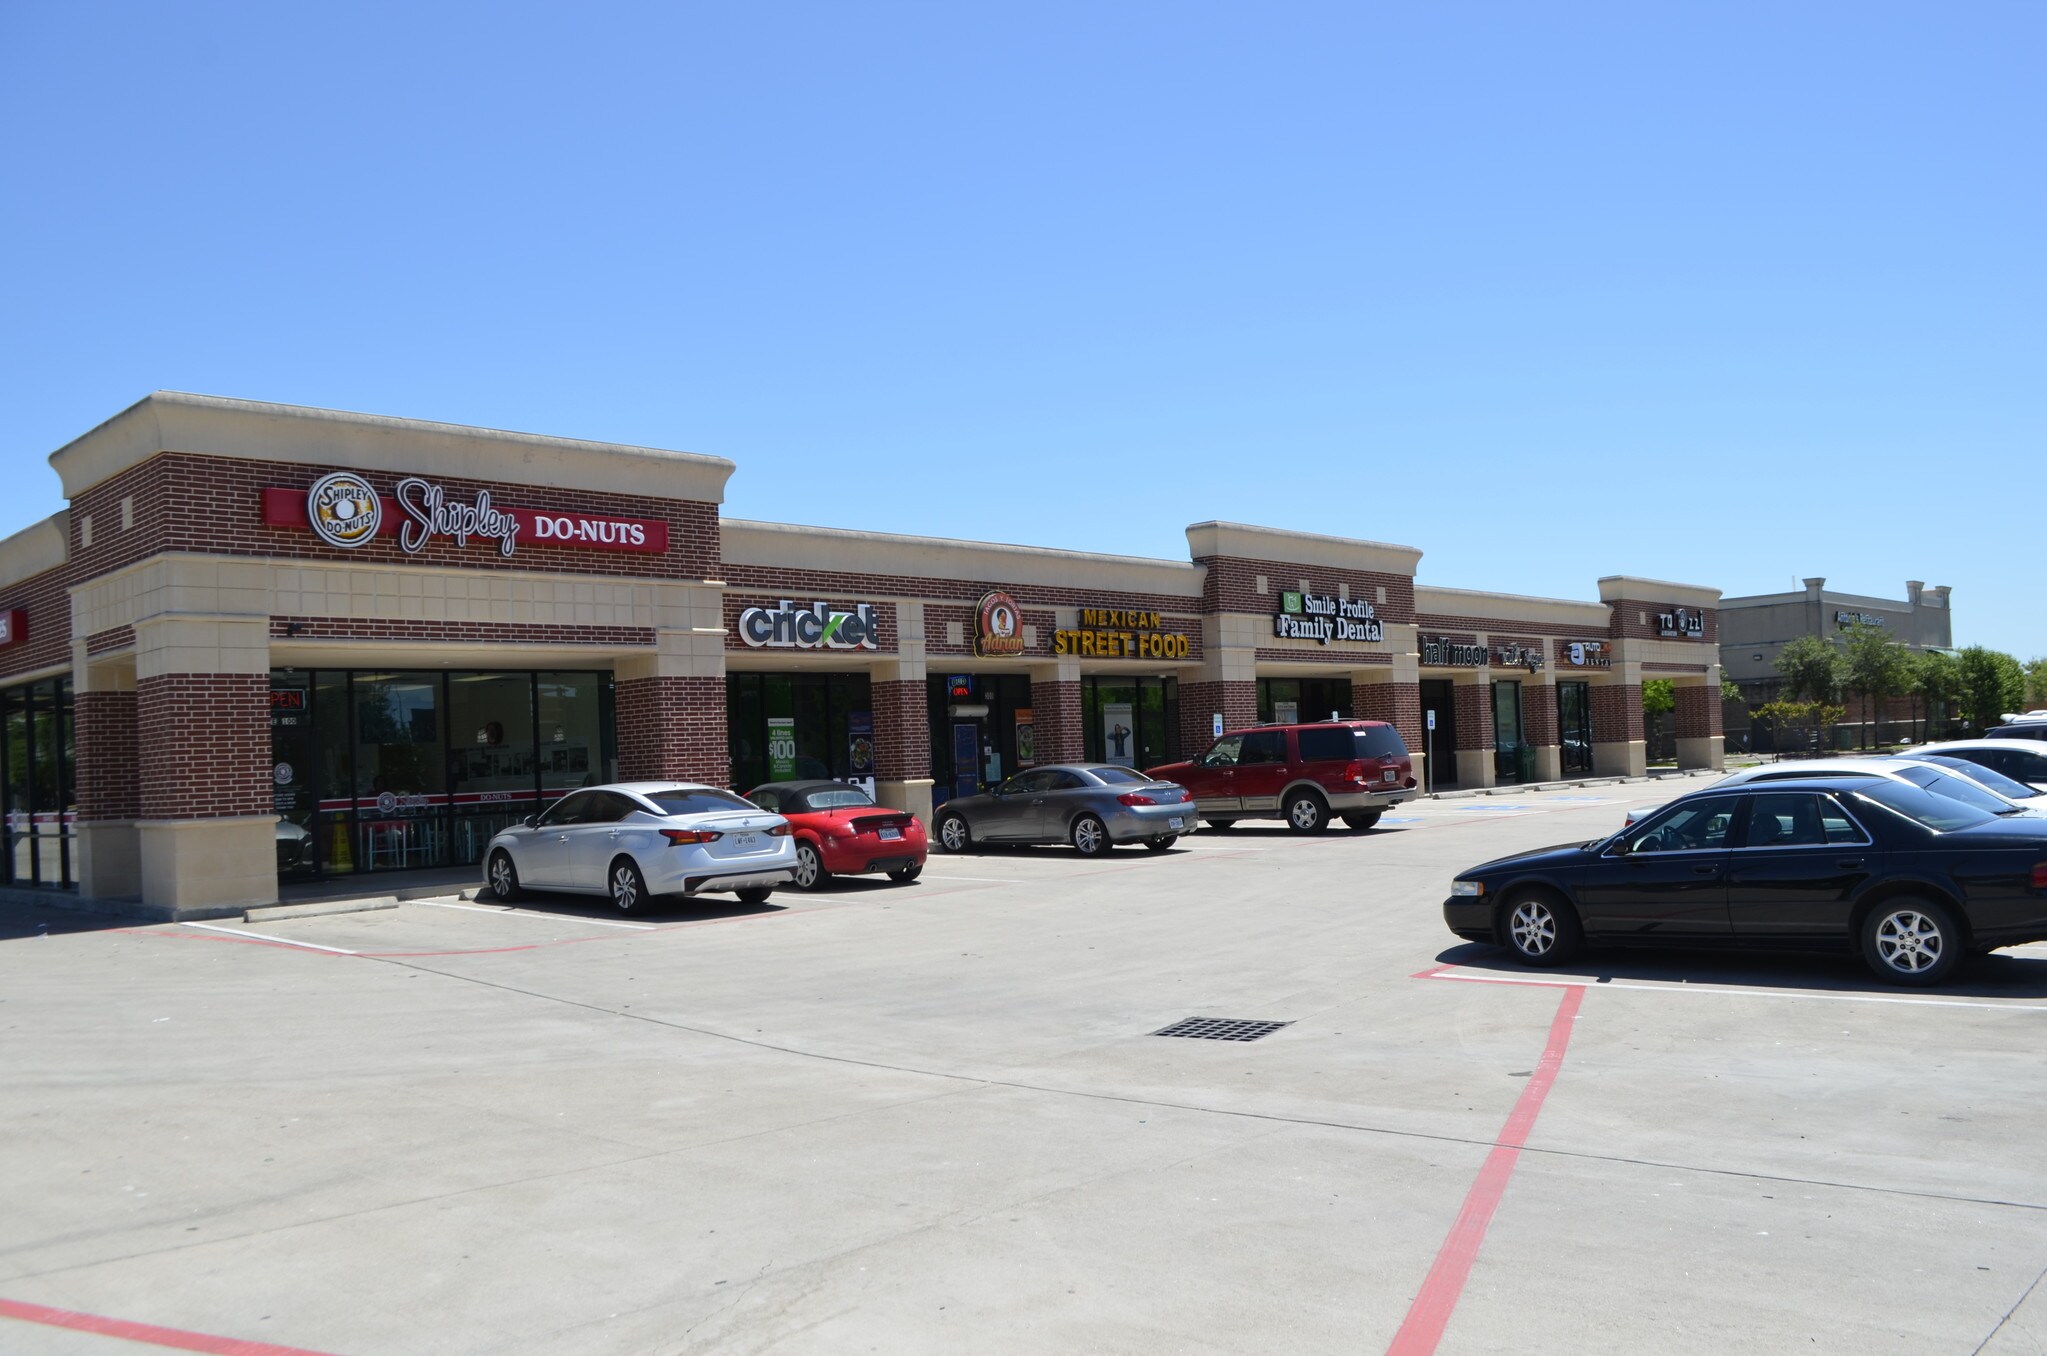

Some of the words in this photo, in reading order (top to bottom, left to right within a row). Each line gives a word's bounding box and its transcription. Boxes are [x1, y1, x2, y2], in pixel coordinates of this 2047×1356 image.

[319, 486, 369, 506] SHIPLEY
[396, 477, 520, 557] Shipley
[535, 516, 645, 545] DO-NUTS
[1305, 594, 1337, 615] Smile
[1339, 598, 1375, 620] Profile
[739, 600, 879, 649] cricket
[1083, 608, 1161, 629] MEXICAN
[1279, 613, 1334, 646] Family
[1337, 617, 1385, 642] Dental
[982, 632, 1024, 651] Adrian
[1054, 628, 1132, 656] STREET
[1139, 633, 1190, 658] FOOD
[1422, 636, 1449, 665] half
[1452, 644, 1488, 666] moon
[1583, 642, 1601, 652] AUTO
[271, 691, 301, 707] PEN
[953, 687, 968, 697] OPEN
[769, 740, 795, 759] $100
